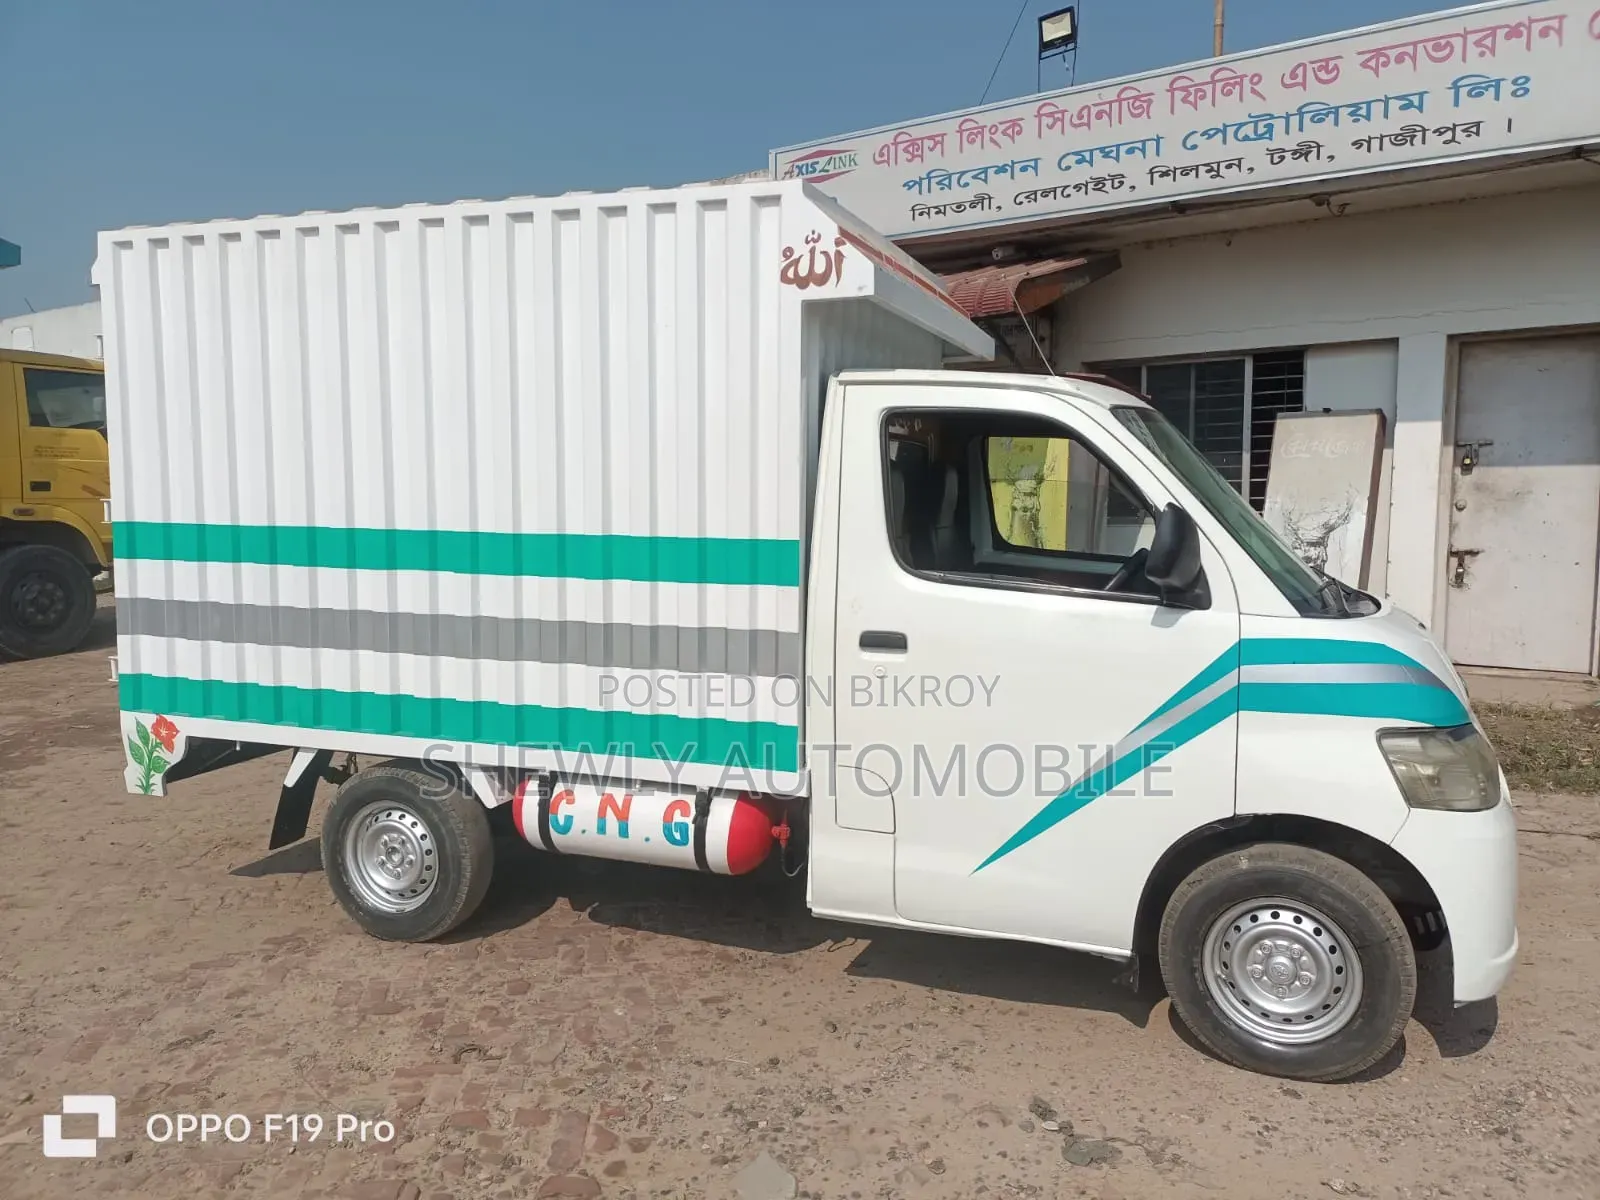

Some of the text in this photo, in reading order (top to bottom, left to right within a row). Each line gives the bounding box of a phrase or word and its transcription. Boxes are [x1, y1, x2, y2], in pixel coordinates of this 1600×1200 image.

[902, 73, 1531, 196] পরিবেশন মেঘনা পেট্রোলিয়াম লিঃ
[956, 117, 1025, 154] লিংক
[1034, 86, 1155, 139] সিএনজি
[1165, 66, 1267, 115] ফিলিং
[1281, 55, 1343, 92] এন্ড
[1357, 13, 1568, 78] কনভারশন
[910, 193, 1002, 222] নিমতলী,
[1013, 170, 1137, 207] রেলগেইট,
[1146, 157, 1254, 187] শিলমুন,
[1266, 140, 1335, 166] টঙ্গী,
[1351, 118, 1485, 154] গাজীপুর
